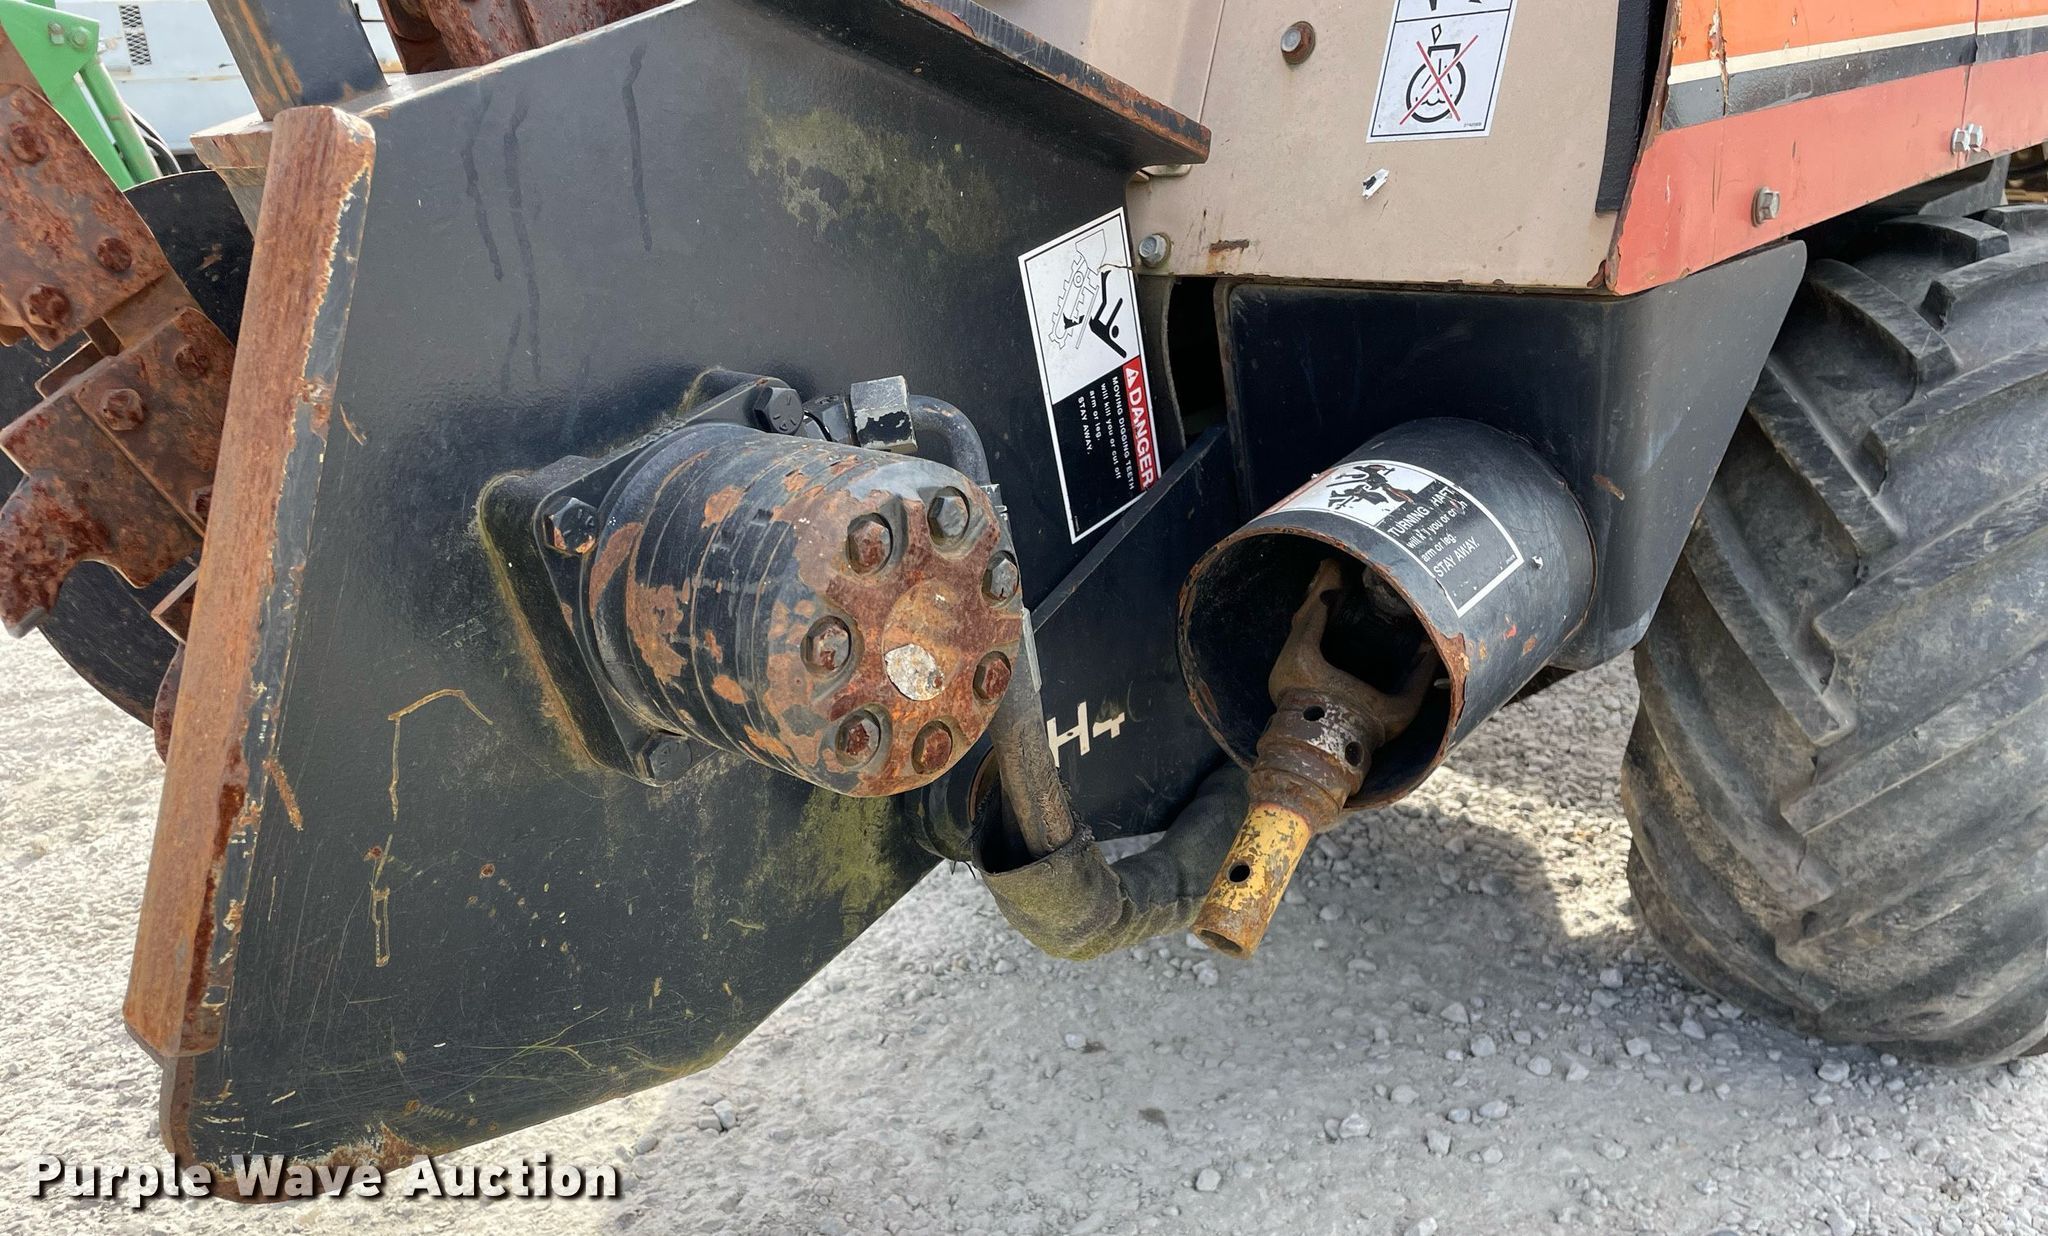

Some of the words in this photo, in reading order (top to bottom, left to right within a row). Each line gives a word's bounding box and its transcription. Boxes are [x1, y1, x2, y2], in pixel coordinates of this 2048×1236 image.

[1089, 390, 1097, 408] arm
[1093, 410, 1099, 420] or
[1101, 383, 1109, 399] will
[1078, 396, 1088, 421] STAY
[1083, 424, 1093, 455] AWAY.
[1106, 419, 1114, 436] you
[1109, 438, 1116, 448] or
[1112, 376, 1123, 415] MOVING
[1118, 417, 1130, 459] DIGGING
[1125, 460, 1135, 490] TEETH
[1129, 387, 1155, 488] DANGER
[1387, 506, 1431, 538] TURNING
[1427, 486, 1455, 511] HAFT
[1406, 535, 1421, 549] will
[1427, 520, 1443, 535] you
[1440, 513, 1451, 524] or
[1421, 548, 1437, 562] arm
[1434, 541, 1444, 552] or
[1433, 555, 1457, 578] STAY
[1453, 536, 1480, 561] AWAY.
